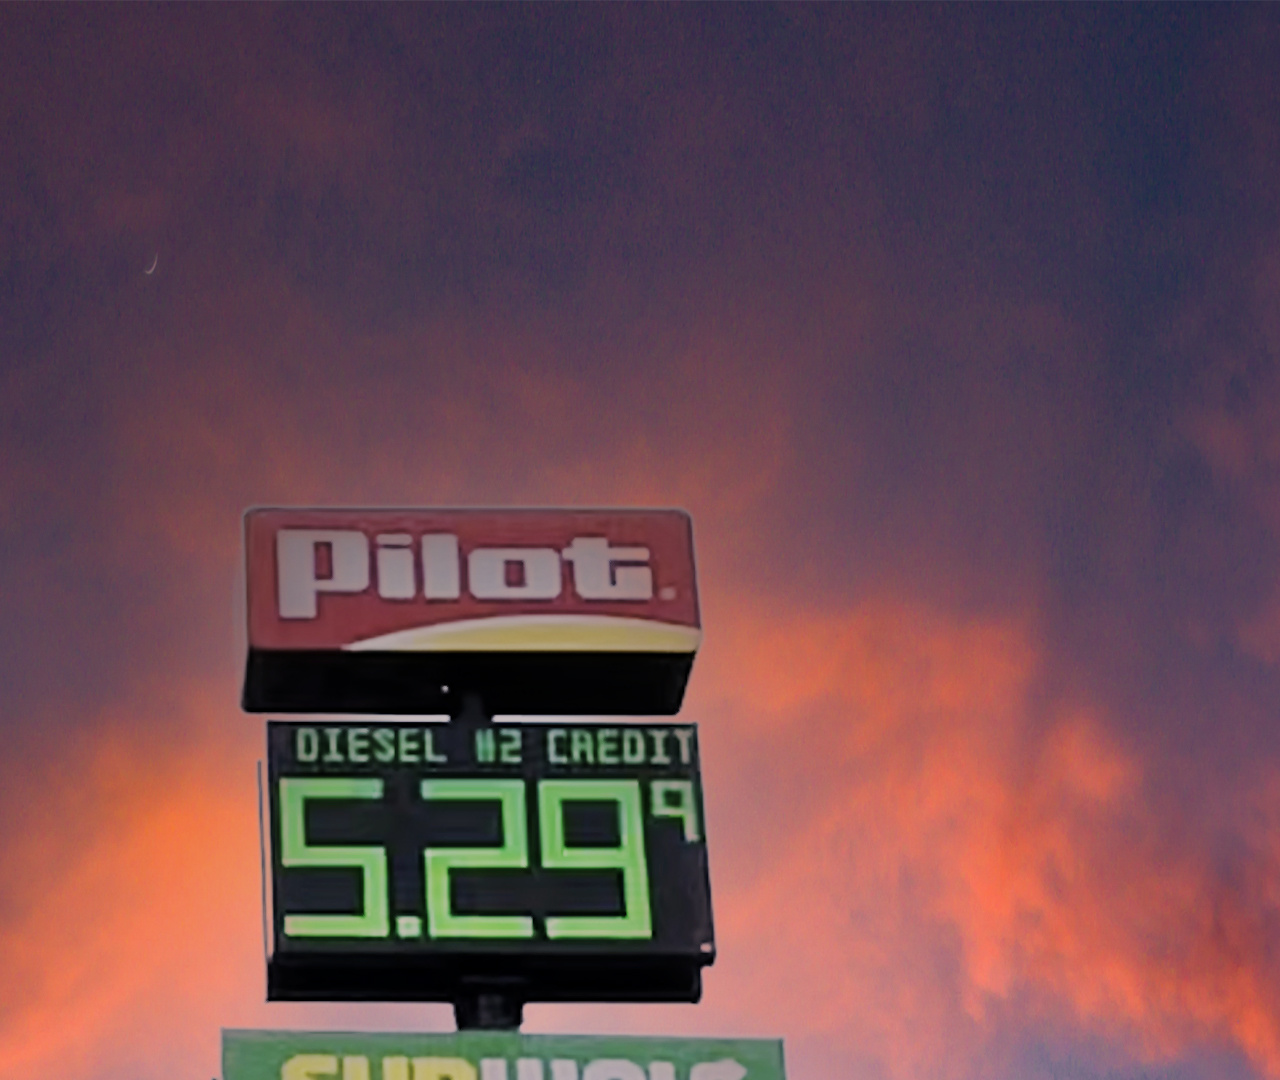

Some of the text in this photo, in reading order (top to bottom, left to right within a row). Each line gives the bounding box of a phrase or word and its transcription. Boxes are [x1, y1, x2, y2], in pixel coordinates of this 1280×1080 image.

[276, 529, 654, 619] Pilot
[296, 727, 694, 765] DIESEL #2 CREDIT
